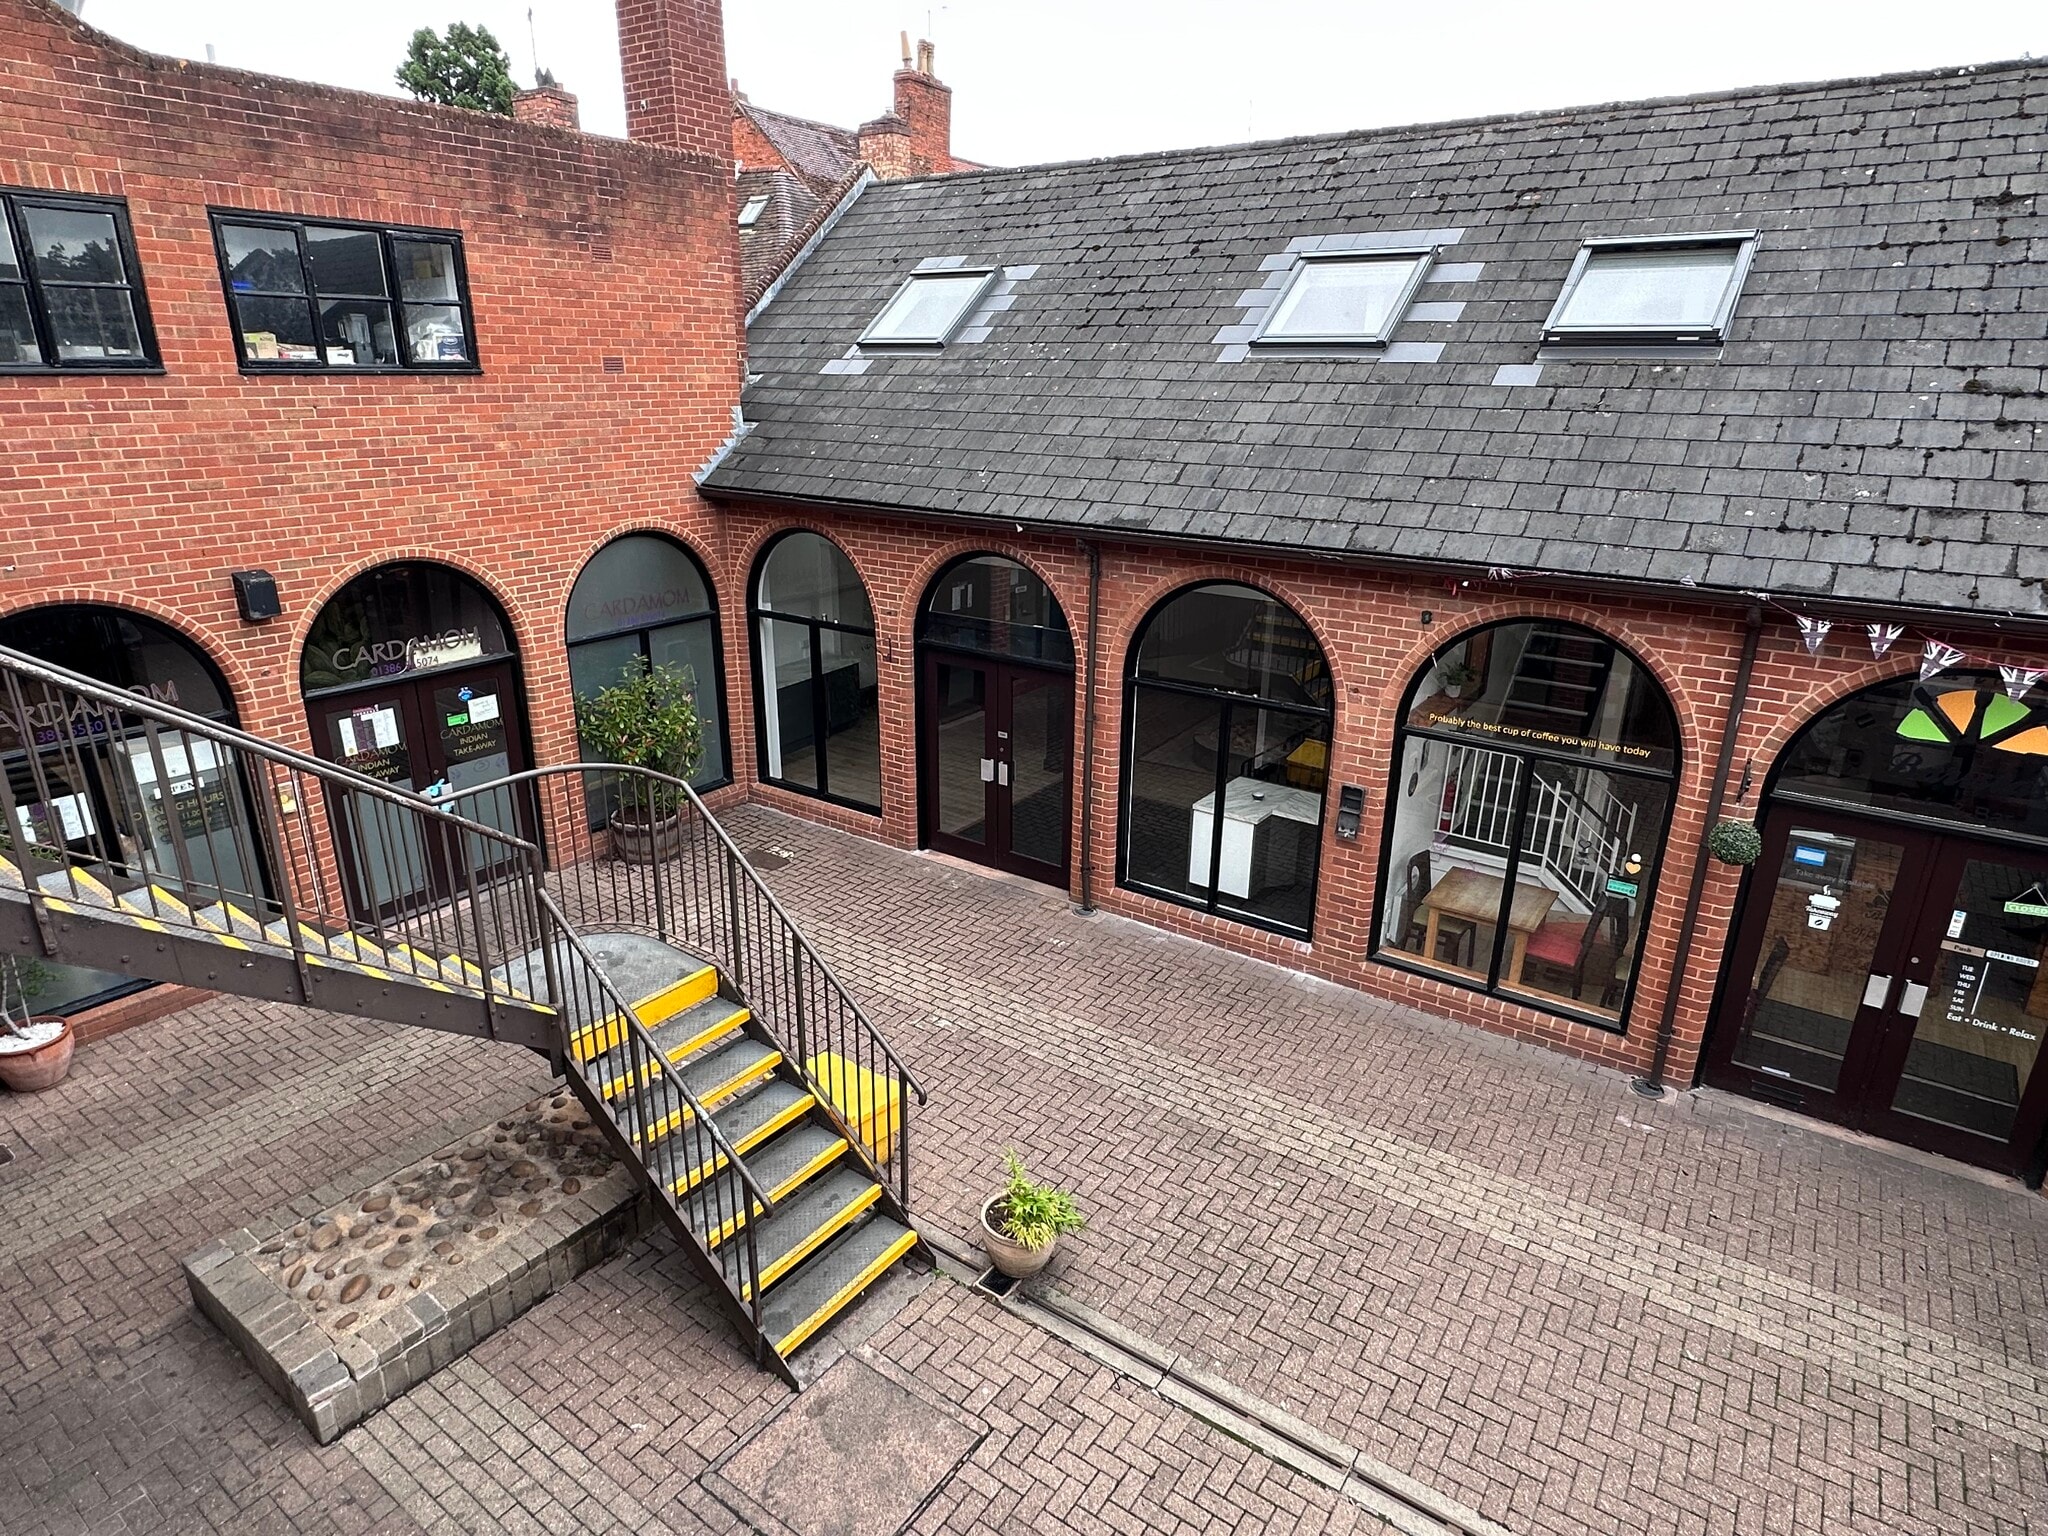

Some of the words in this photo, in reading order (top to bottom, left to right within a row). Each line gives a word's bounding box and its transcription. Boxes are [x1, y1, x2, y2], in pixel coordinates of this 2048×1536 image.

[584, 586, 690, 622] CARDAMOM
[333, 625, 480, 671] CARDAMOM
[440, 717, 504, 740] CARDAMOM
[459, 732, 488, 745] INDIAN
[1429, 713, 1466, 728] Probably
[1467, 719, 1481, 730] the
[1483, 722, 1502, 732] best
[1503, 726, 1519, 737] cup
[1520, 728, 1532, 737] of
[1532, 731, 1559, 743] coffee
[1561, 736, 1578, 746] you
[1580, 737, 1597, 748] will
[1598, 741, 1621, 753] have
[1623, 746, 1651, 758] today
[357, 756, 391, 773] INDIAN
[2008, 903, 2048, 915] CLOSED
[1956, 980, 1971, 989] THU
[1959, 972, 1976, 981] WED
[1946, 1012, 1963, 1022] Eat
[1972, 1018, 1998, 1031] Drink
[2008, 1027, 2037, 1041] Relax
